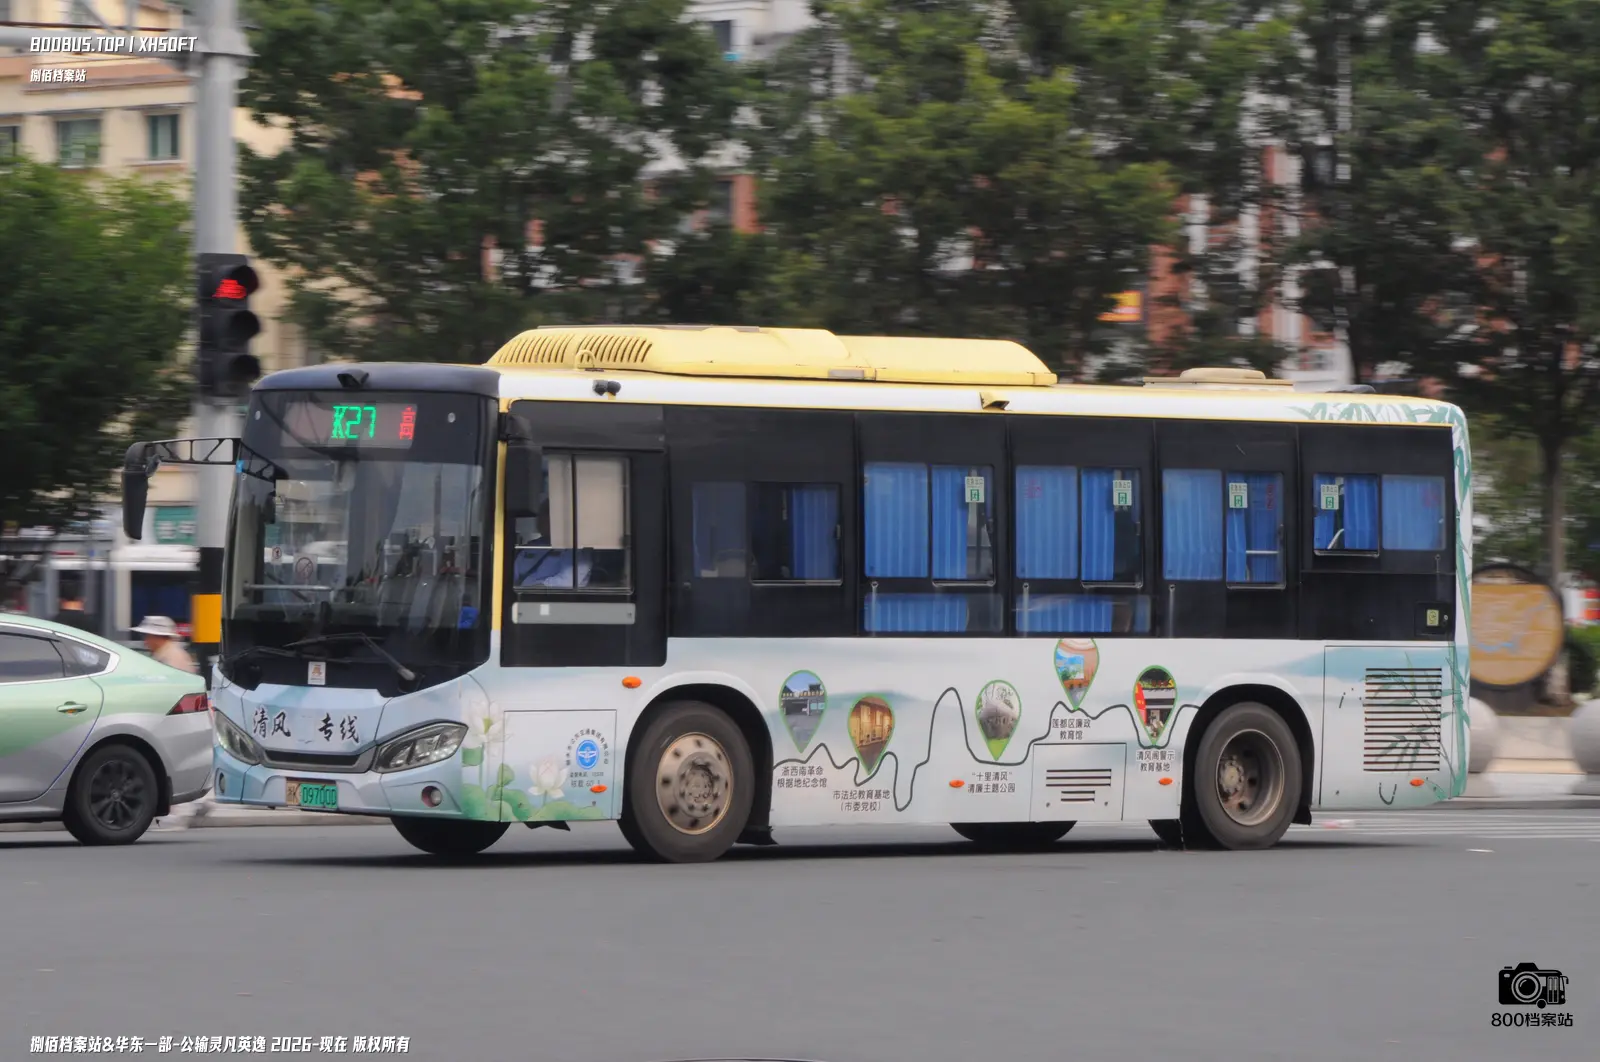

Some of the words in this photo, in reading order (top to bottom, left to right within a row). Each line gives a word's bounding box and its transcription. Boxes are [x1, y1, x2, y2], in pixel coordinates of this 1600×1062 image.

[331, 405, 377, 439] K27
[399, 405, 417, 441] 高
[253, 707, 291, 738] 清风
[318, 712, 359, 744] 专线
[1060, 730, 1083, 740] 教育馆
[1140, 762, 1171, 772] 教育基地
[777, 777, 827, 789] 根据地纪念馆
[967, 783, 1016, 793] 清廉主题公园
[832, 789, 890, 800] 市法纪教育基地
